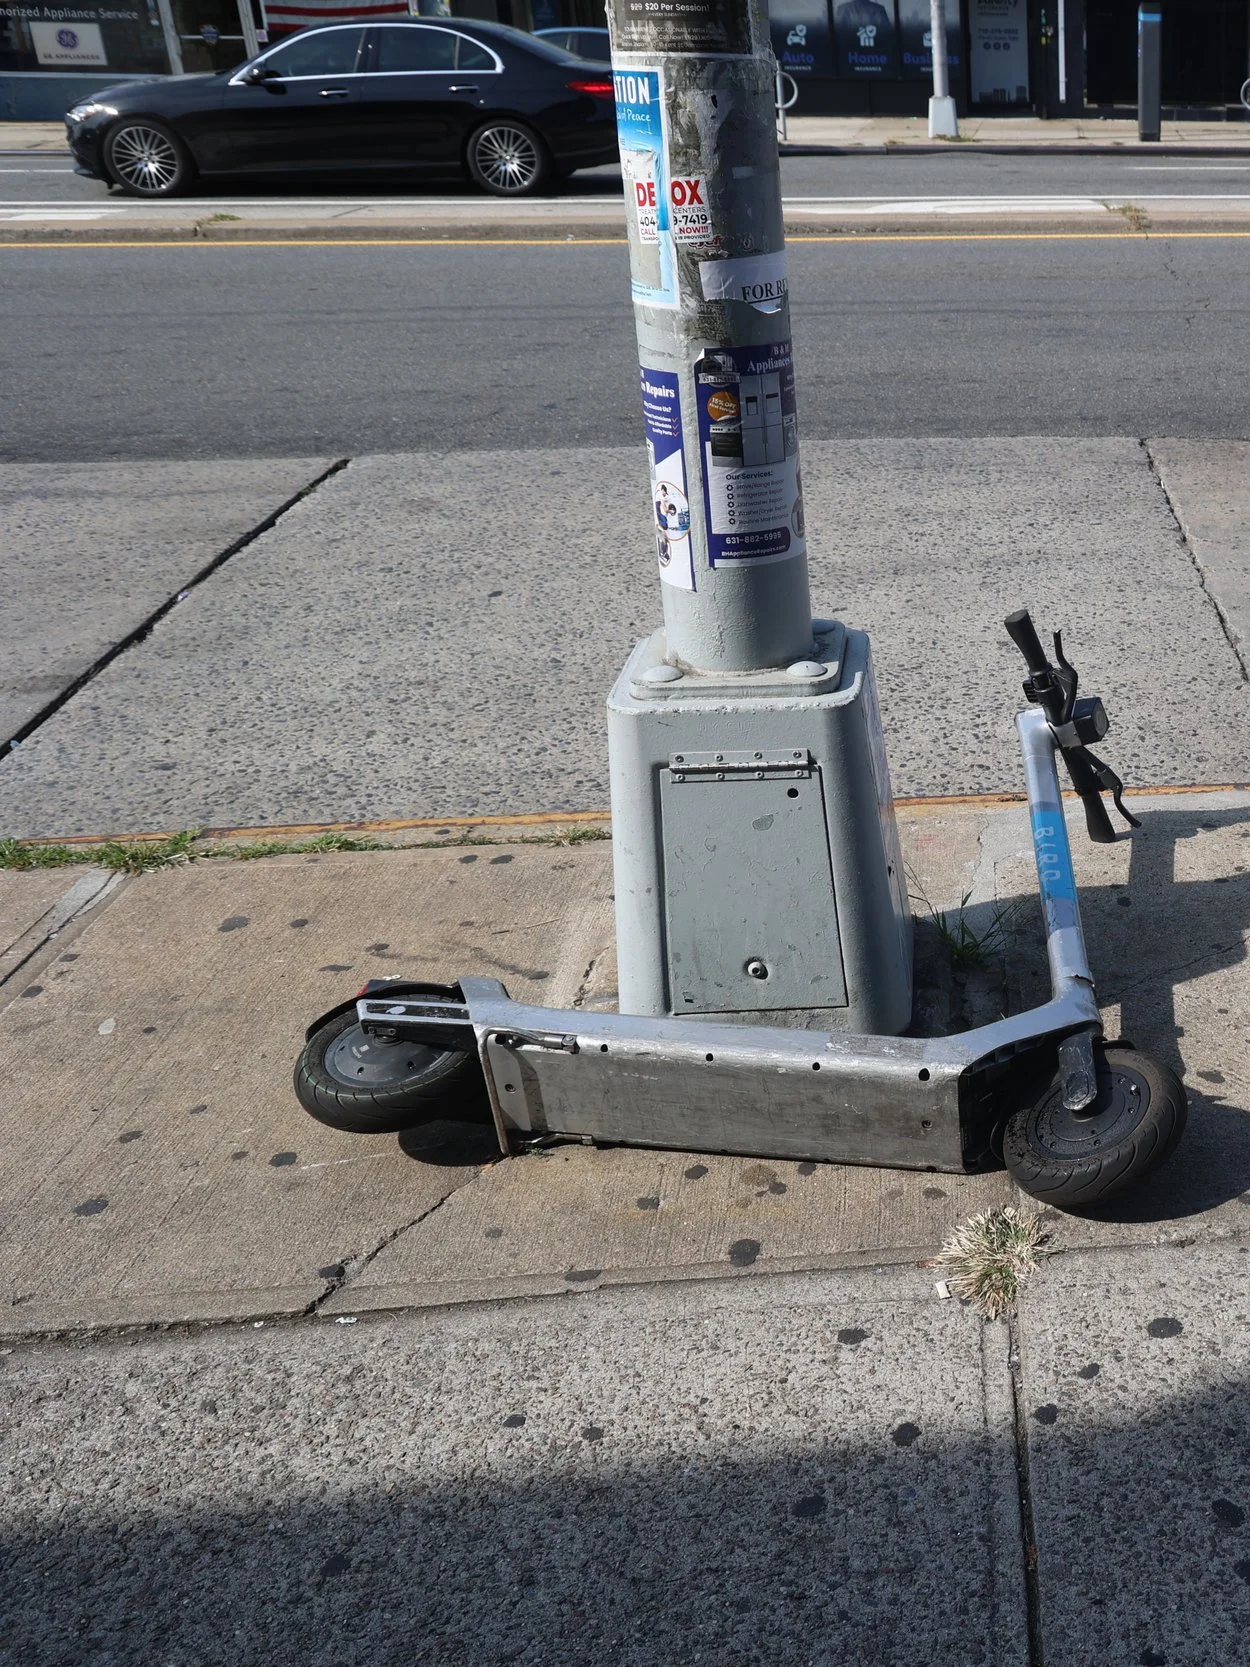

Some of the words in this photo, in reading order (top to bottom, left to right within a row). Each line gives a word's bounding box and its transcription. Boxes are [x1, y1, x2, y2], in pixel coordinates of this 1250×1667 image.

[43, 7, 96, 19] Appliance
[98, 8, 138, 19] Service
[645, 2, 659, 11] $20
[660, 3, 674, 11] Per
[782, 51, 814, 64] Auto
[848, 51, 888, 64] Home
[903, 52, 960, 65] Busiss
[626, 109, 651, 122] Peace
[635, 180, 704, 207] DEOX
[673, 206, 707, 214] CENTERS
[641, 227, 656, 236] CALL
[678, 226, 709, 234] NOW!!!
[741, 282, 775, 300] FOR
[646, 381, 675, 398] Repairs
[741, 471, 773, 480] Services:
